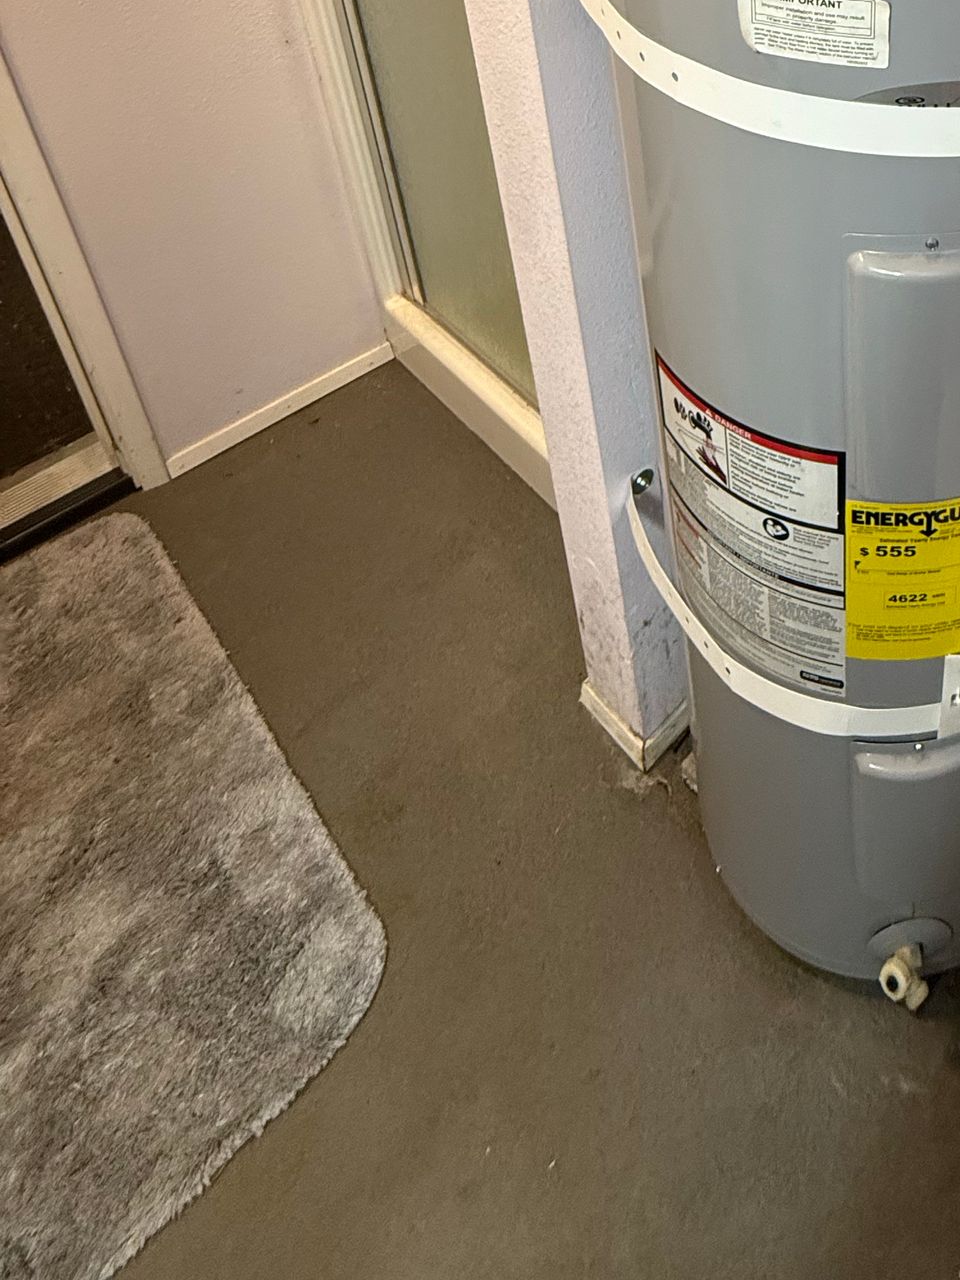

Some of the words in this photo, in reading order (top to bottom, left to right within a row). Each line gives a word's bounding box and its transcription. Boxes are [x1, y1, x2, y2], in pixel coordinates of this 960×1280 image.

[714, 414, 752, 440] DANGER
[860, 546, 870, 557] $
[875, 546, 917, 558] 555
[888, 593, 928, 602] 4622
